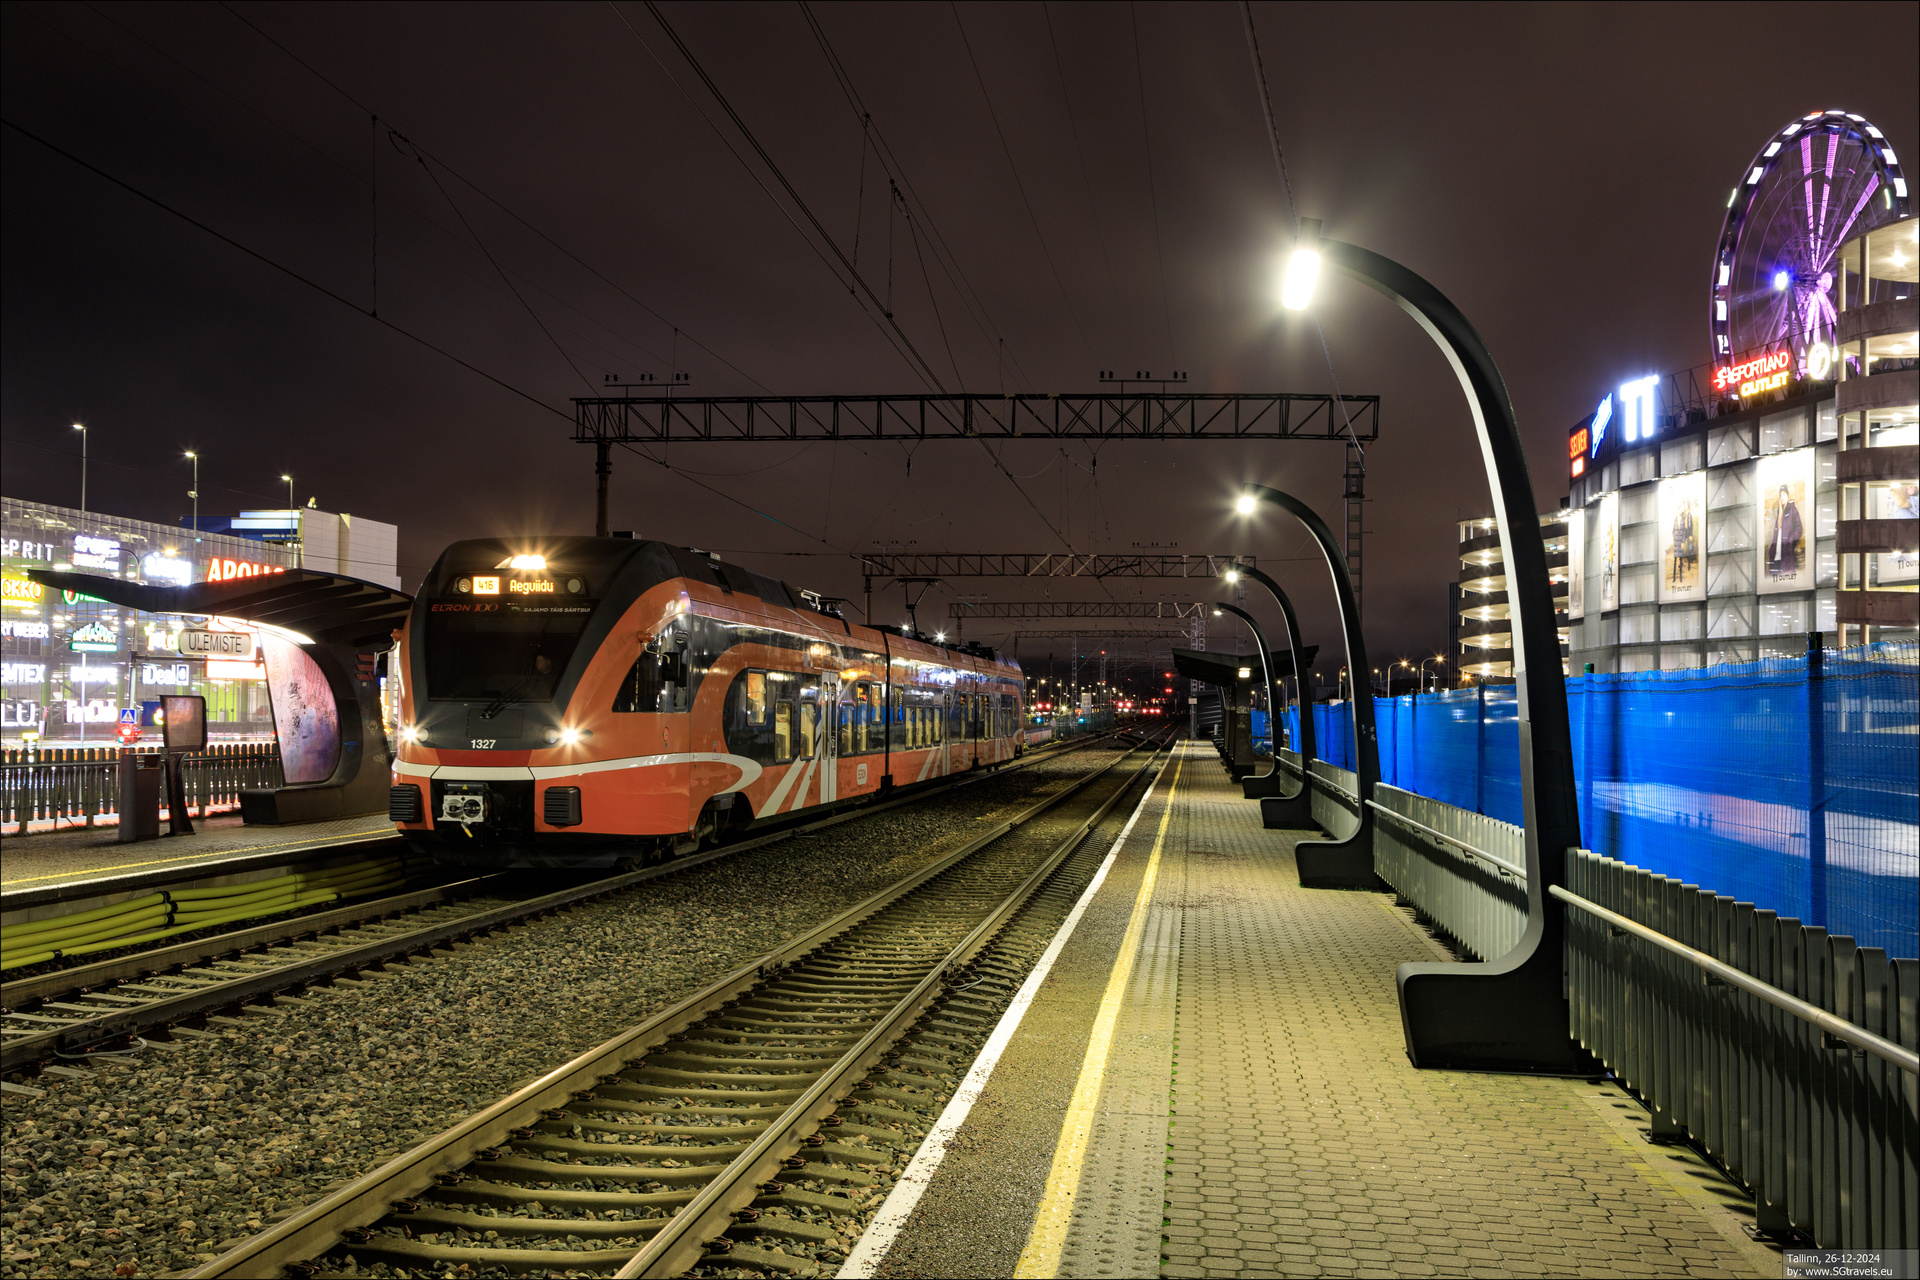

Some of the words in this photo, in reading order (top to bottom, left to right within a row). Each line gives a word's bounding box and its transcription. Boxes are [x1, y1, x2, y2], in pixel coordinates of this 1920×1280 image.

[1741, 371, 1789, 397] OUTLET
[479, 580, 494, 590] 416
[509, 579, 554, 595] Aegviidu
[431, 604, 471, 612] ELRON
[473, 603, 498, 612] 100
[188, 630, 242, 653] ÜLEMISTE
[471, 739, 497, 749] 1327
